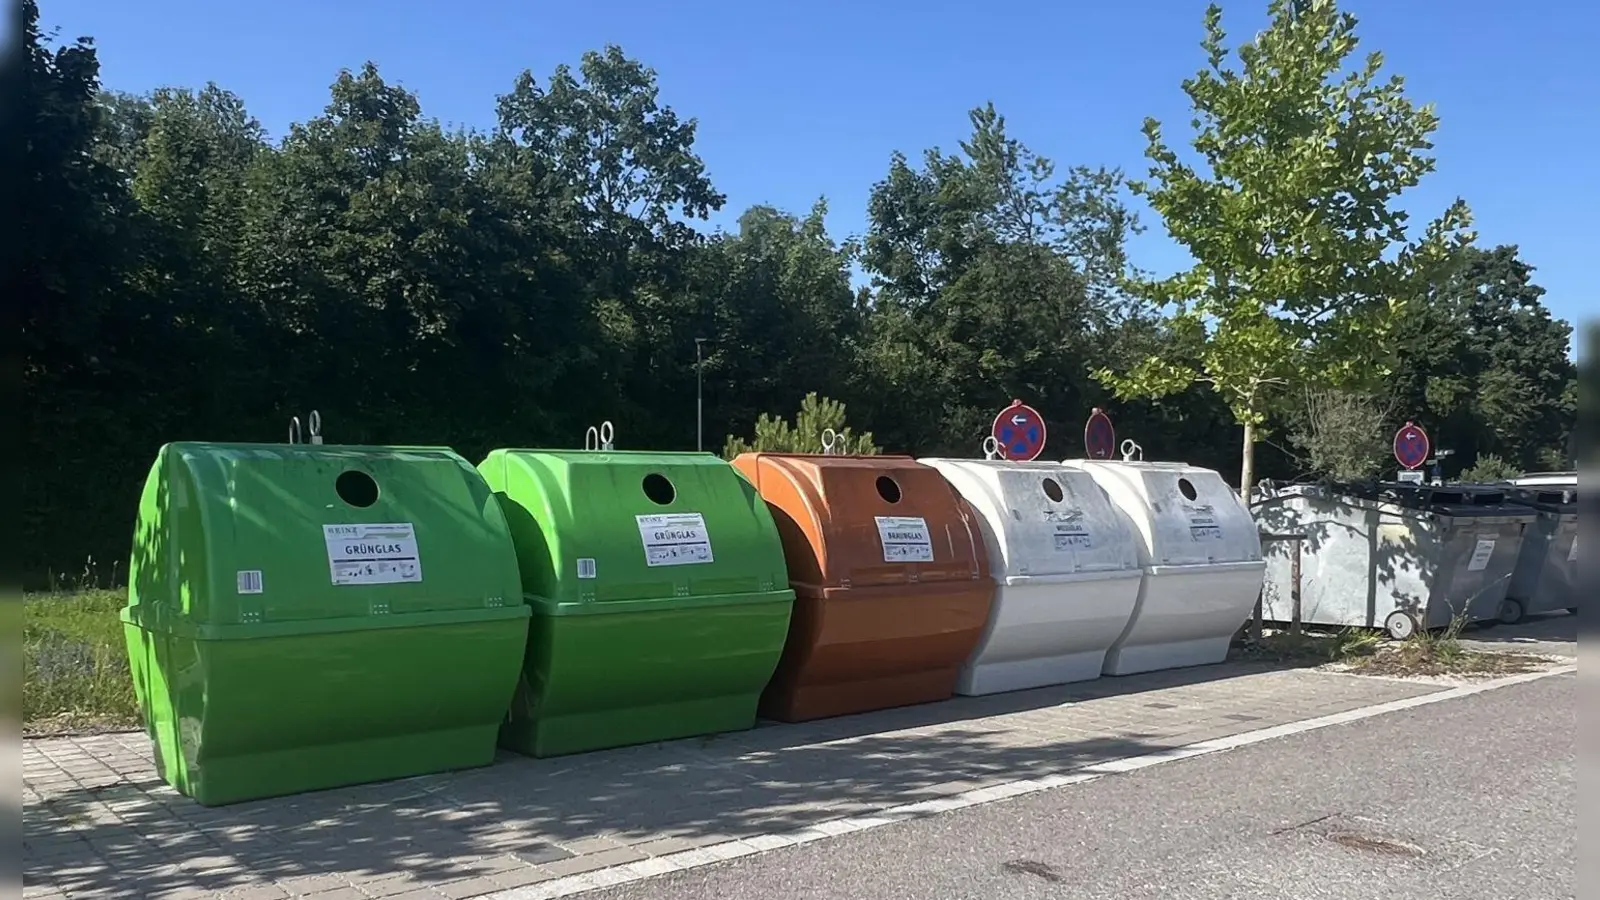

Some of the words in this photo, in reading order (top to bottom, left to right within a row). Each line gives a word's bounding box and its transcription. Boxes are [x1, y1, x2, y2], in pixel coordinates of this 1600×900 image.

[327, 526, 358, 535] HEINZ
[654, 530, 696, 541] GRÜNGLAS
[345, 543, 402, 555] GRÜNGLAS
